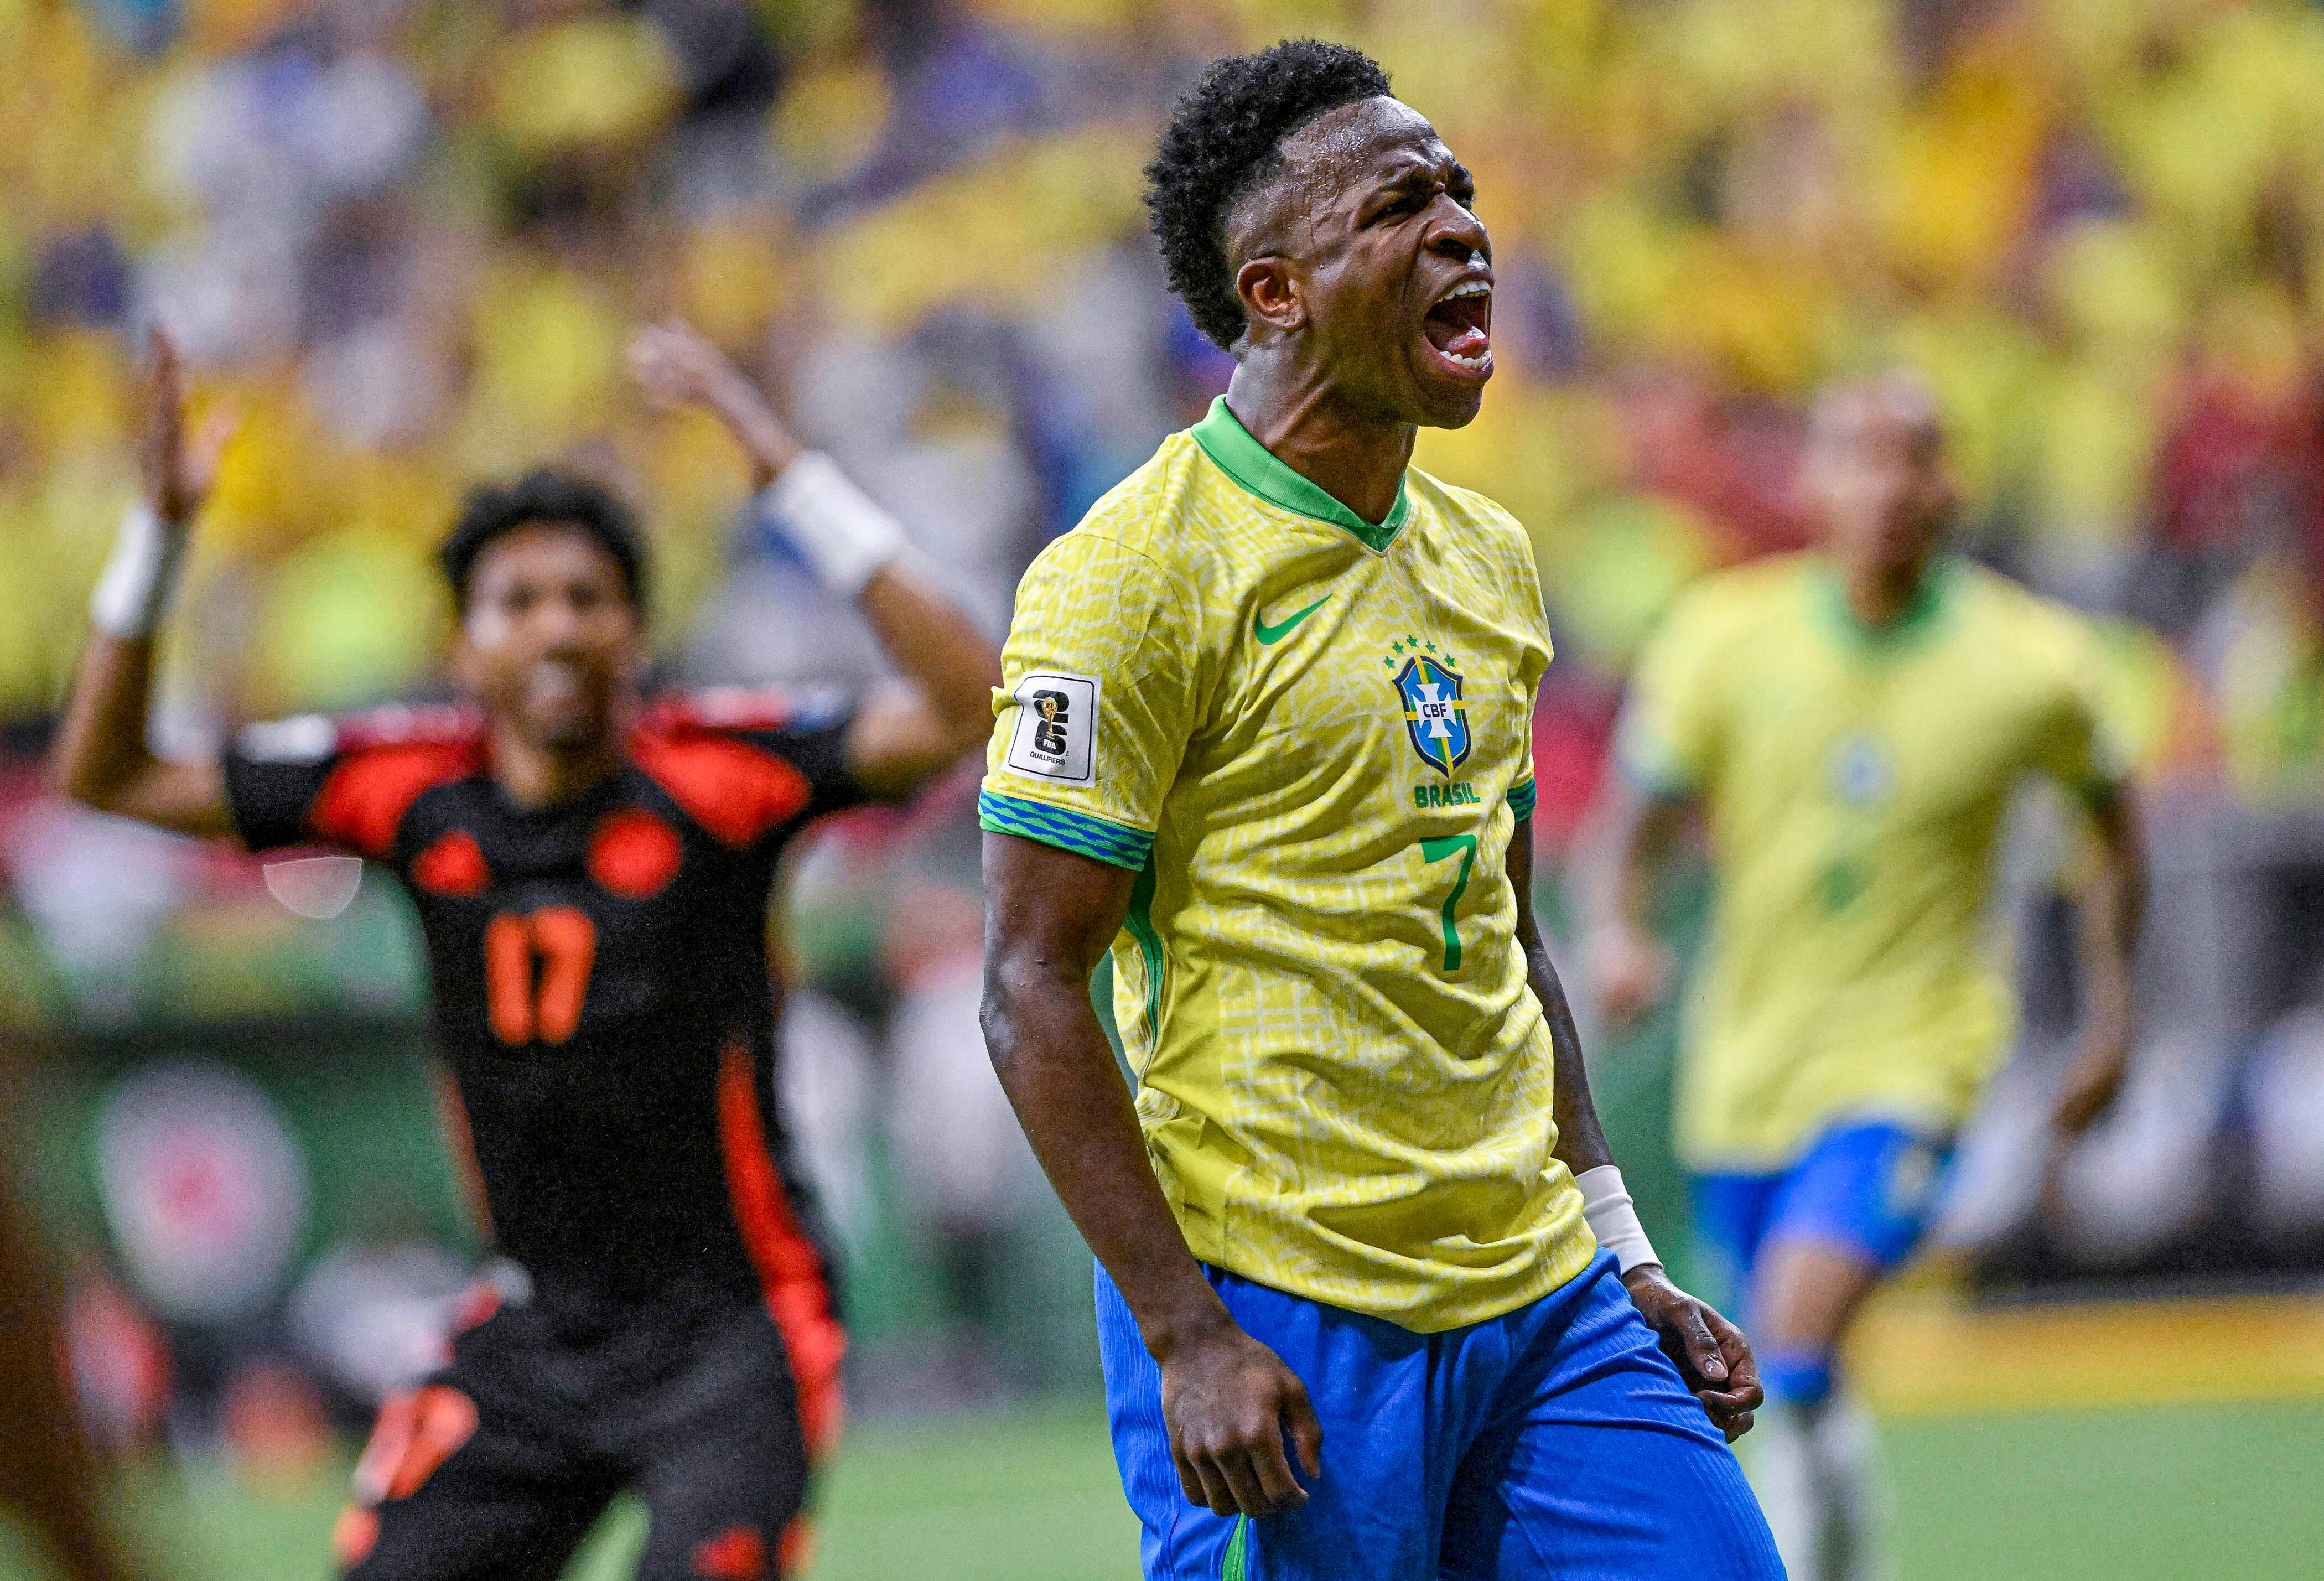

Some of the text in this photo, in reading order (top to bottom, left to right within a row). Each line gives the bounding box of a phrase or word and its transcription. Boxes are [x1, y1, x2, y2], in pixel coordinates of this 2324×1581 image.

[1422, 703, 1448, 718] CBF
[1043, 739, 1057, 750] FIFA
[1030, 751, 1066, 765] QUALIFIERS
[1414, 782, 1481, 808] BRASIL
[1420, 834, 1476, 971] 7
[485, 903, 598, 1046] 17
